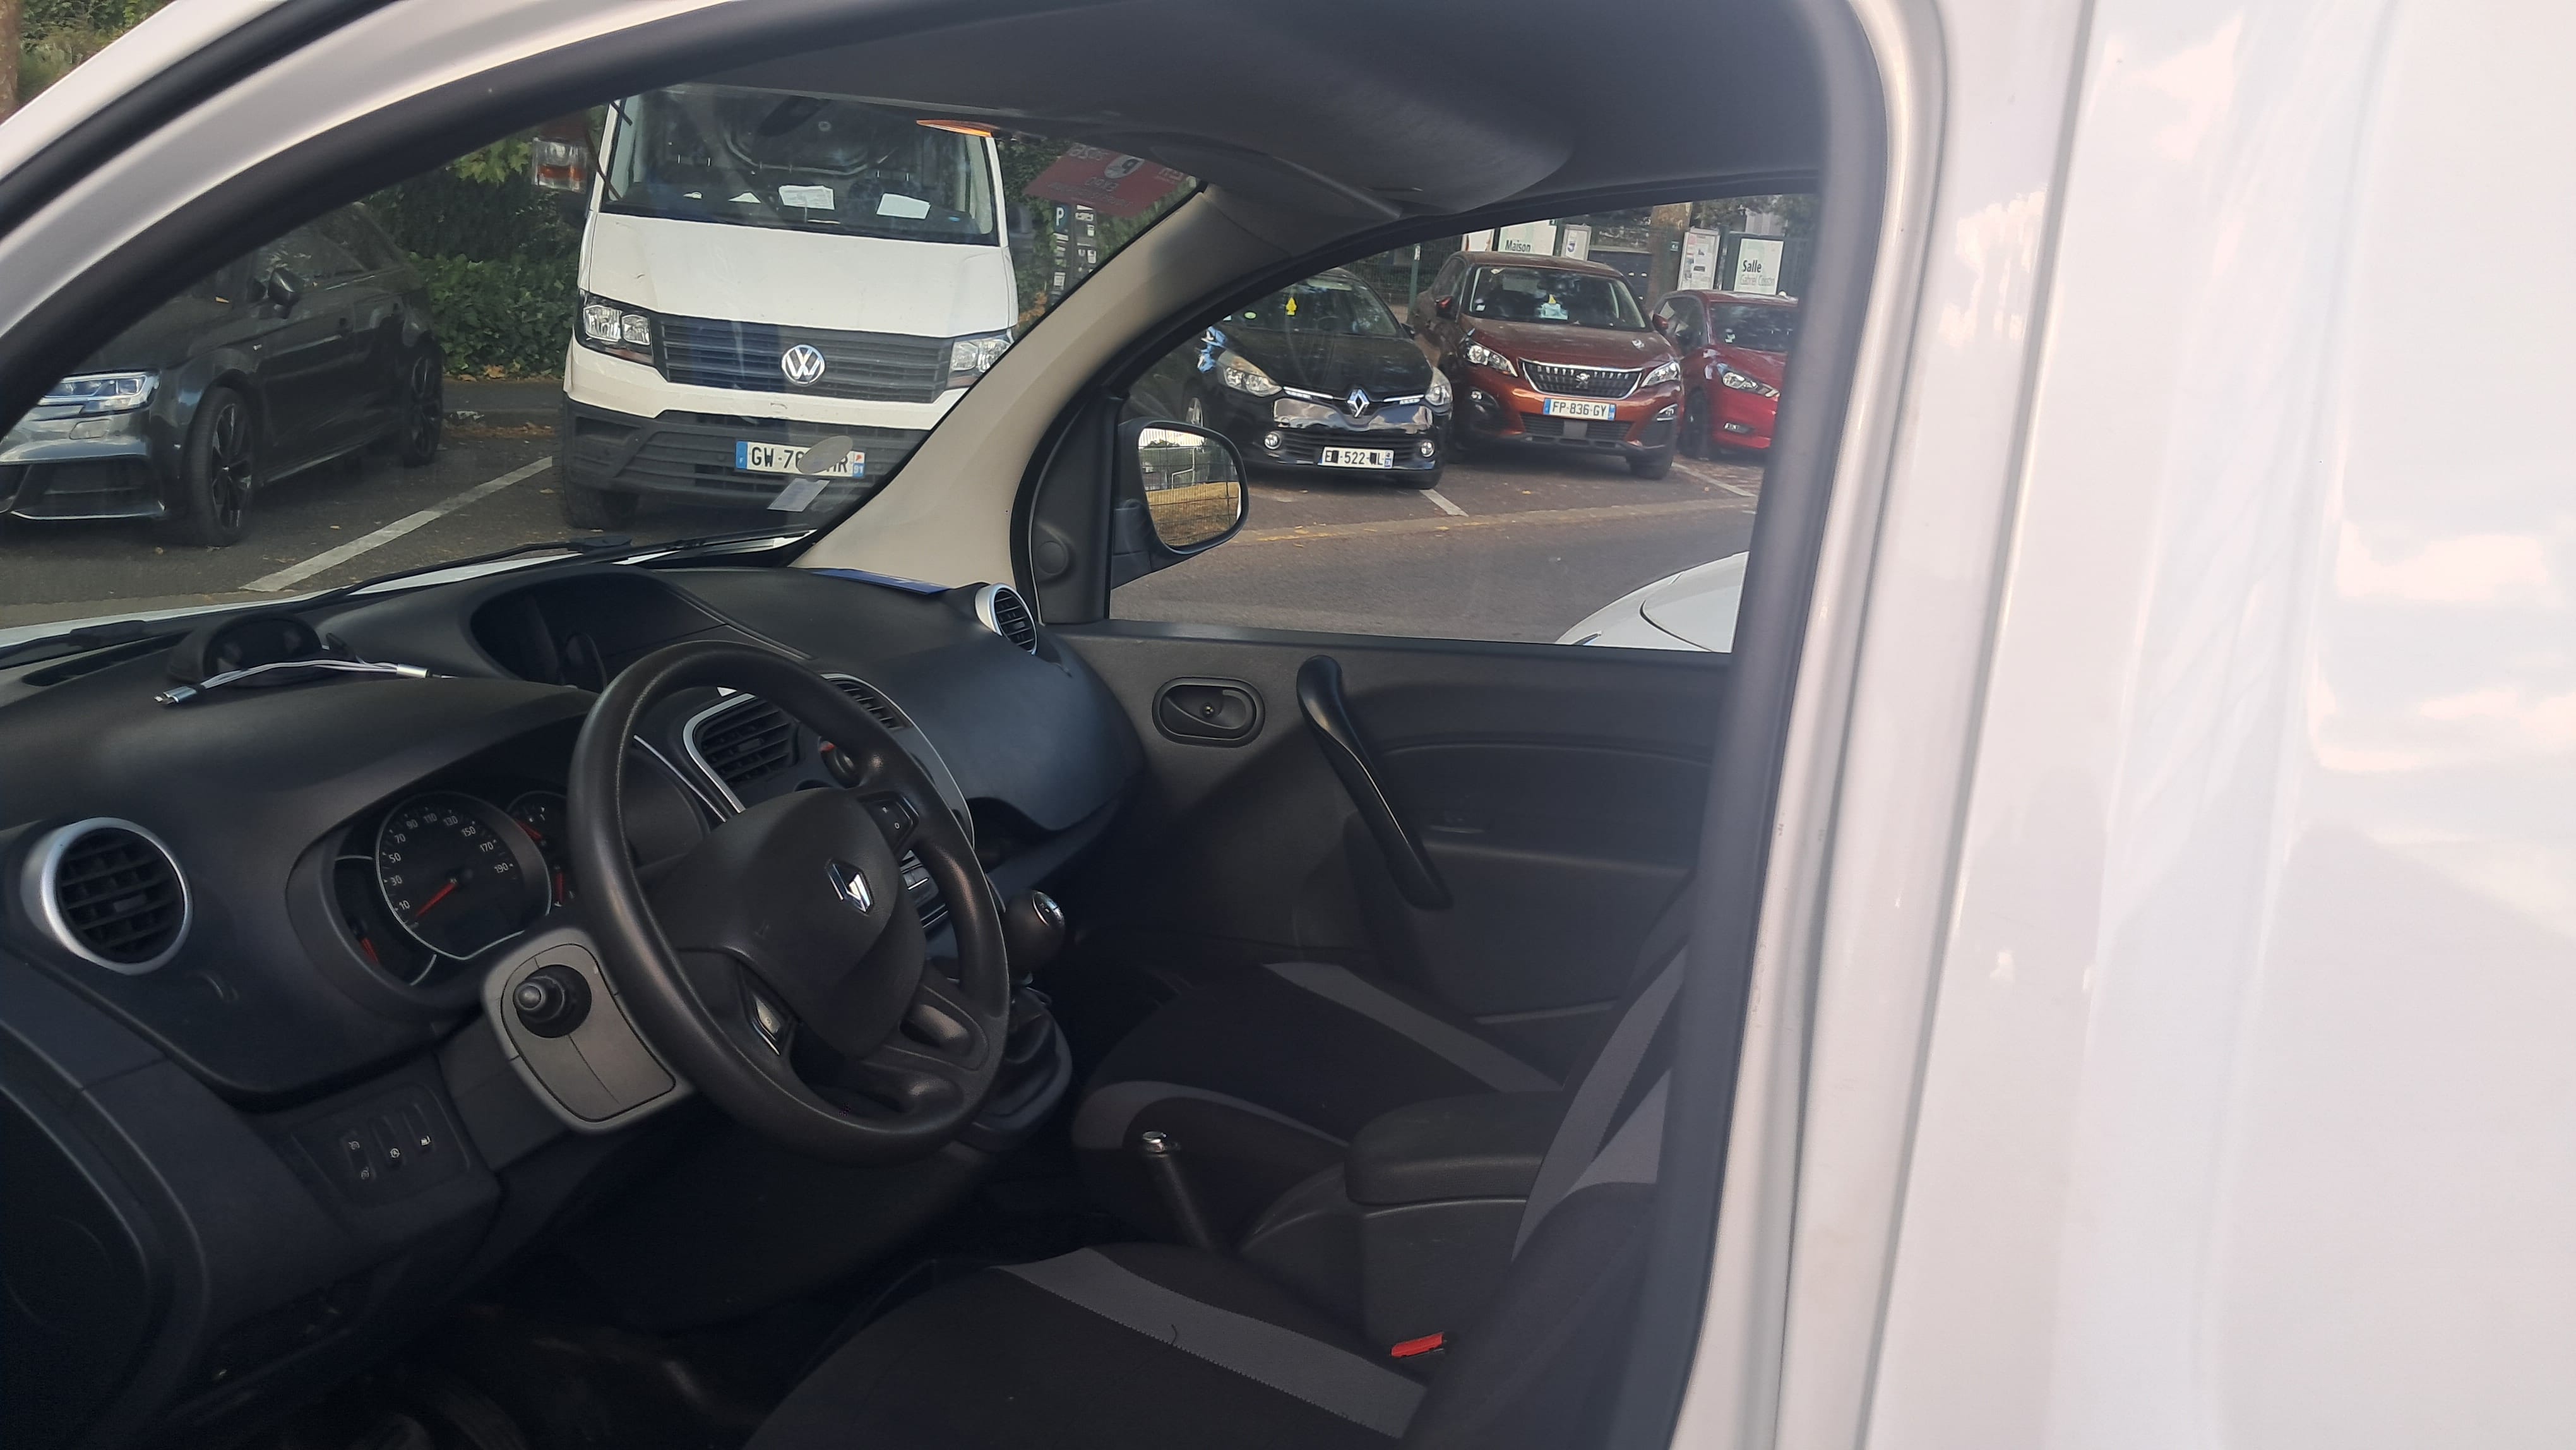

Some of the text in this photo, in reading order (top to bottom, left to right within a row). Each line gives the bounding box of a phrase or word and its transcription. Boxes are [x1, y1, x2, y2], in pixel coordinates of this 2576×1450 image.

[1056, 207, 1064, 226] P
[1505, 239, 1531, 252] Maison
[1742, 260, 1762, 273] Salle
[1552, 401, 1607, 417] FP-836-GY
[406, 819, 418, 829] 90
[424, 813, 438, 824] 110
[444, 816, 458, 825] 130
[462, 827, 476, 837] 150
[394, 833, 406, 844] 70
[479, 841, 494, 852] 170
[389, 853, 402, 863] 50
[494, 863, 508, 873] 190
[391, 875, 403, 886] 30
[398, 900, 410, 910] 10
